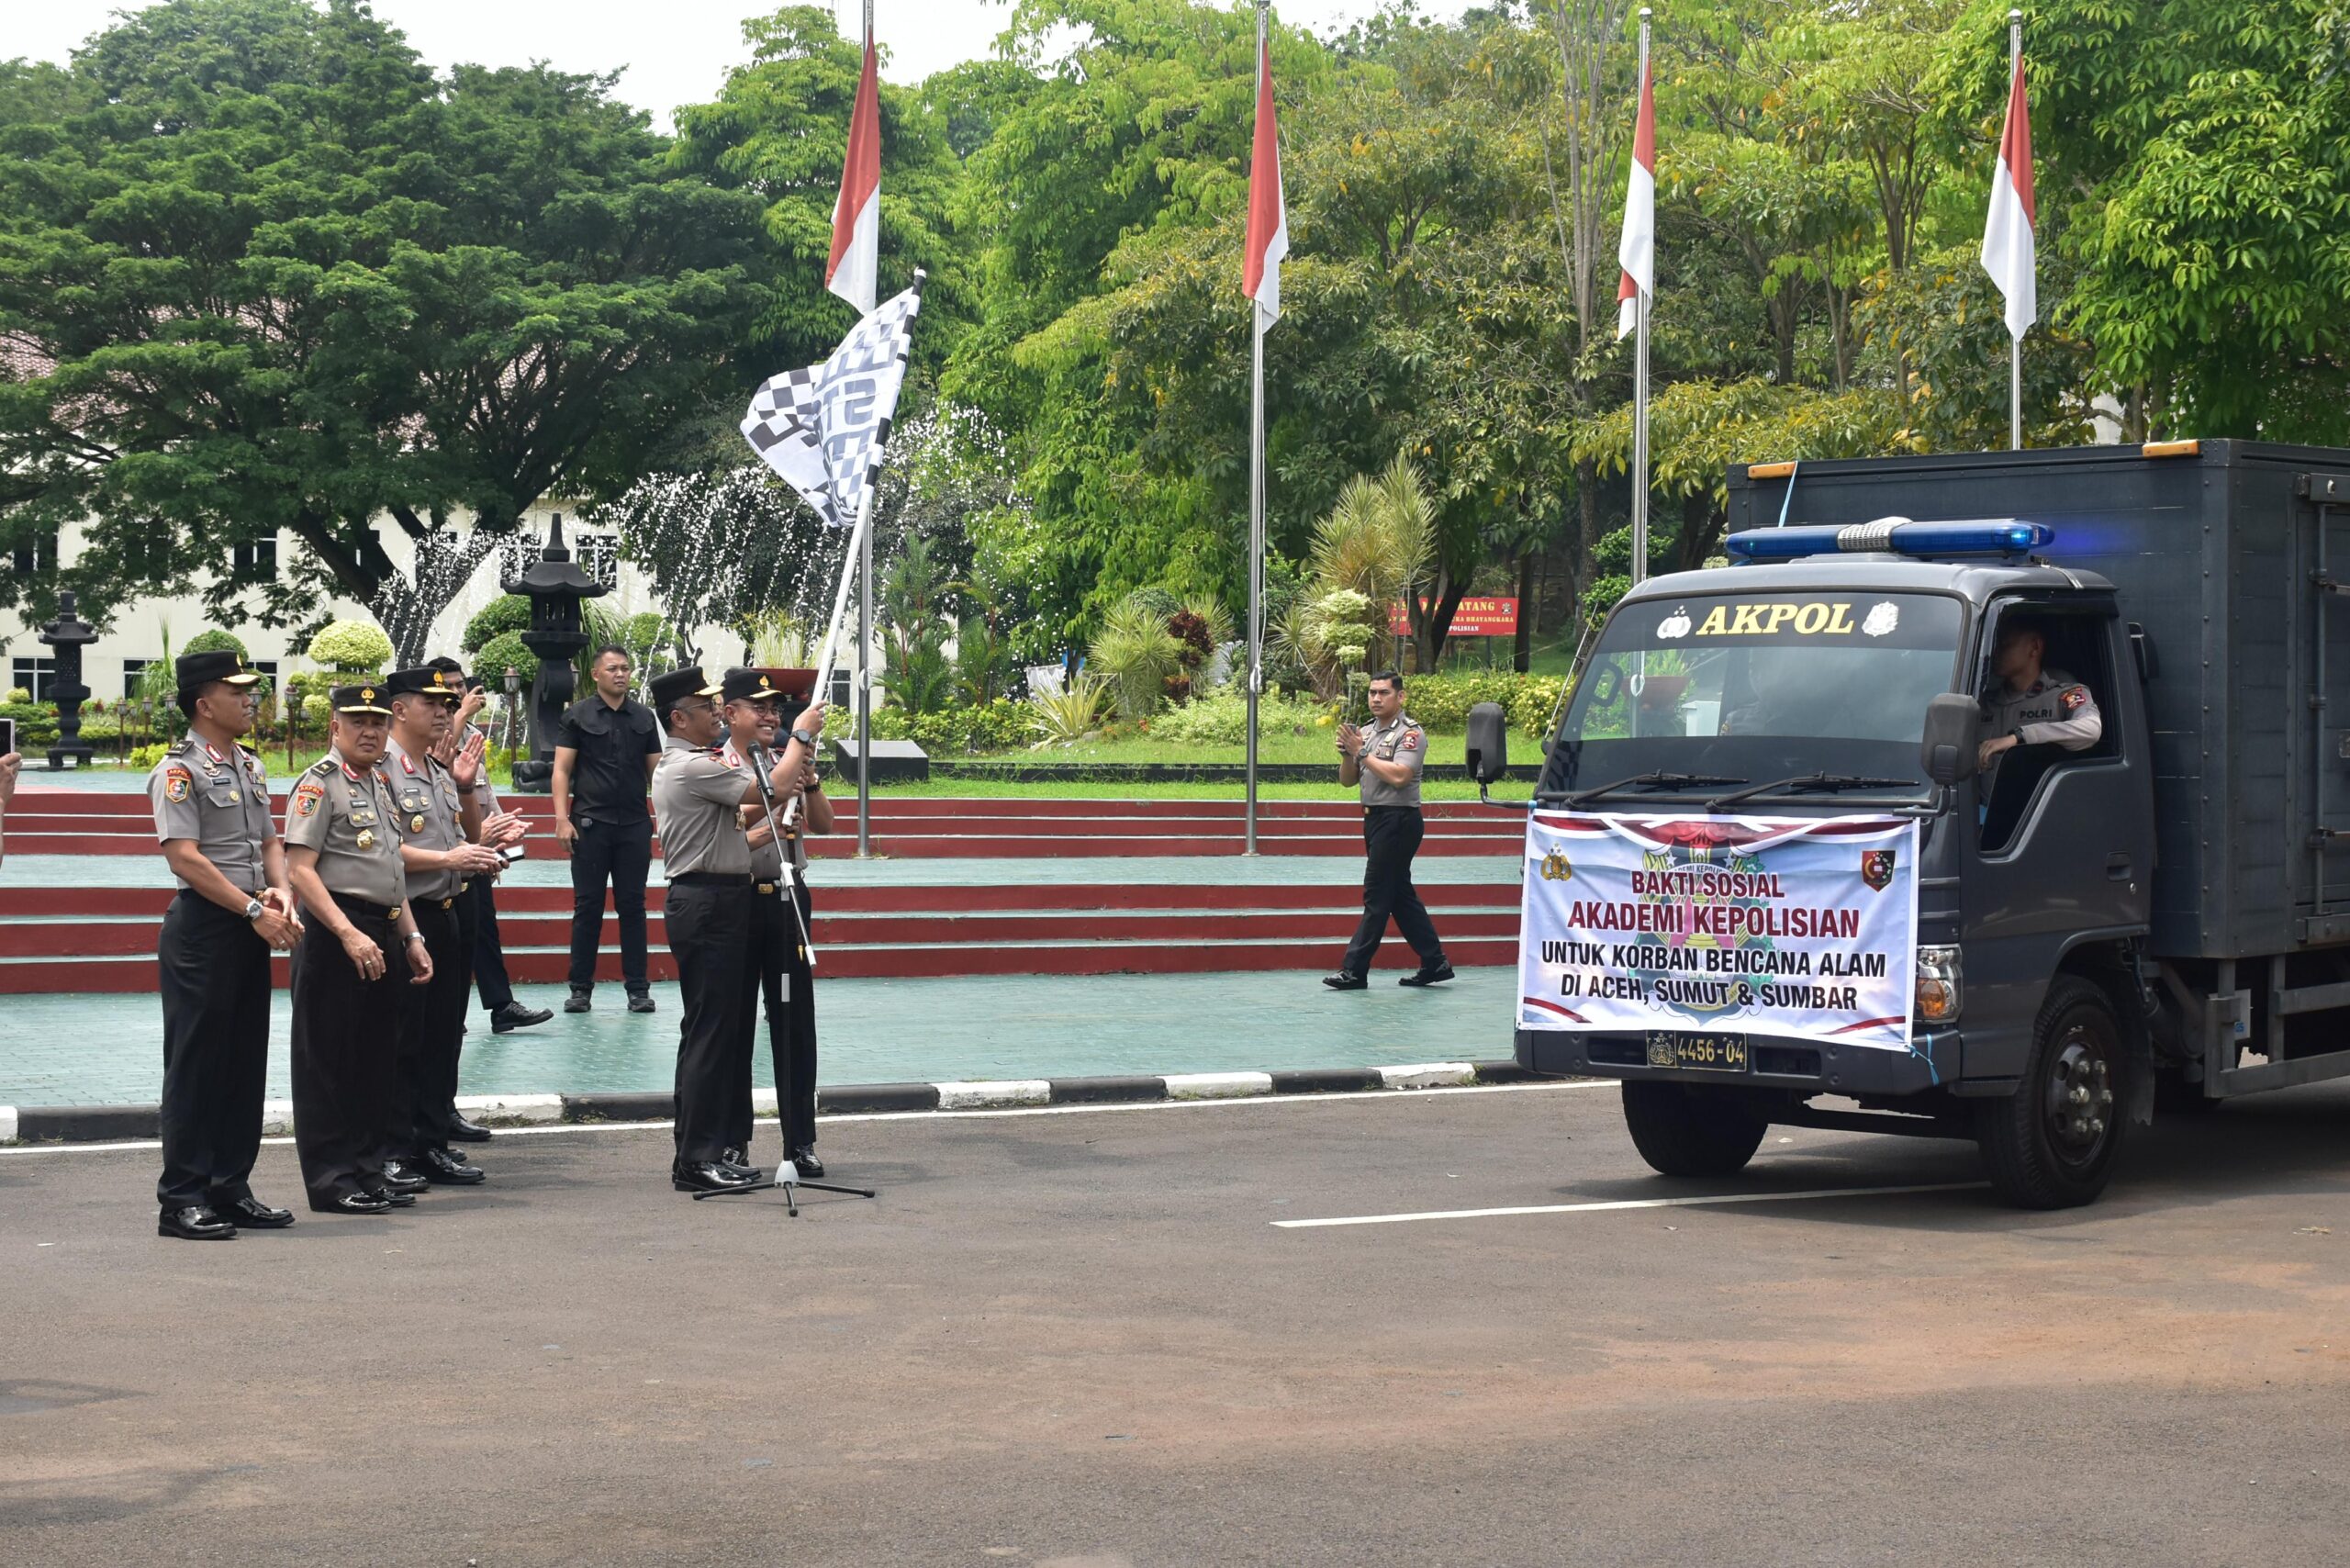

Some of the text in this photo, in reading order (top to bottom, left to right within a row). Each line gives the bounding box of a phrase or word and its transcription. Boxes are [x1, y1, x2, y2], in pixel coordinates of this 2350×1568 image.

[1458, 601, 1495, 611] ATANG
[1695, 603, 1854, 635] AKPOL
[2020, 709, 2053, 719] POLRI
[1631, 870, 1785, 898] BAKTI SOSIAL
[1567, 901, 1860, 938] AKADEMI KEPOLISIAN
[1542, 941, 1886, 978] UNTUK KORBAN BENCANA ALAM
[1561, 973, 1582, 997] DI
[1588, 976, 1650, 1005] ACEH,
[1654, 979, 1729, 1005] SUMUT
[1737, 982, 1755, 1006] &
[1760, 984, 1858, 1011] SUMBAR
